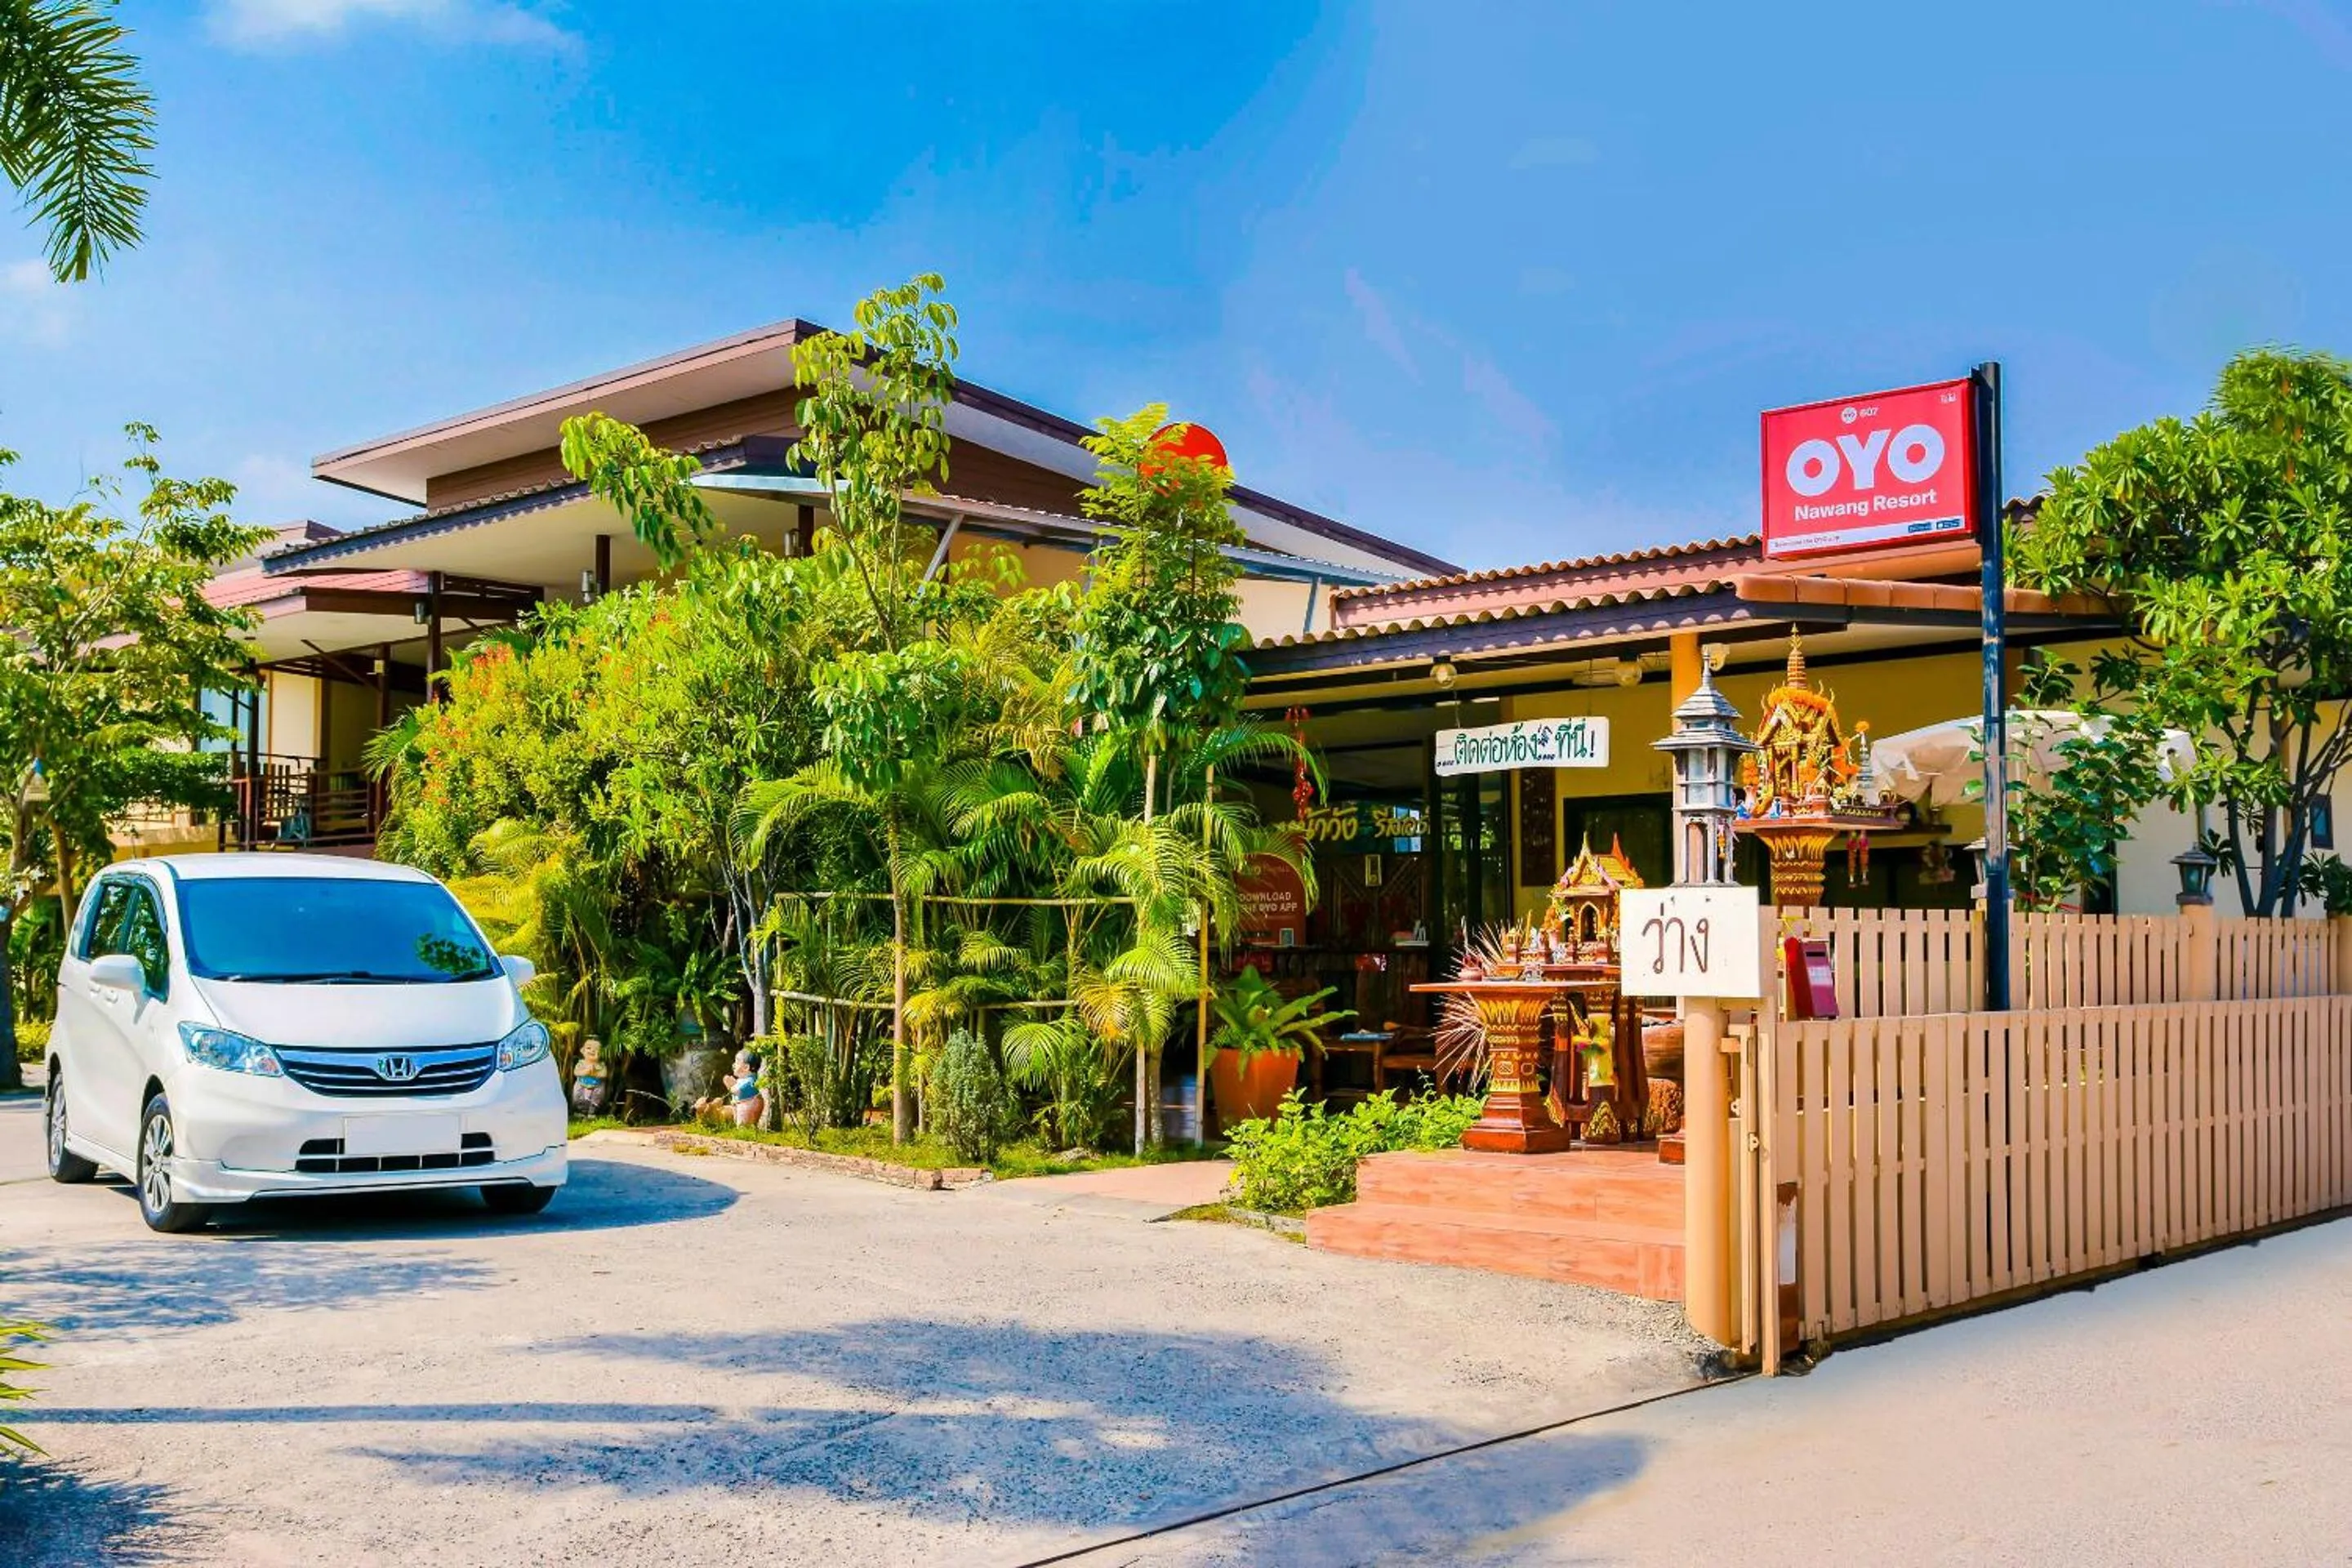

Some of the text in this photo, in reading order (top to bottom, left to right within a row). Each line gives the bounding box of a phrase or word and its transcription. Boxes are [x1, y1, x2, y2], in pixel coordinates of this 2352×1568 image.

[1786, 424, 1945, 497] OYO
[1794, 488, 1938, 521] Nawang Resort
[1280, 902, 1298, 912] APP
[1642, 902, 1710, 974] ว่าง
